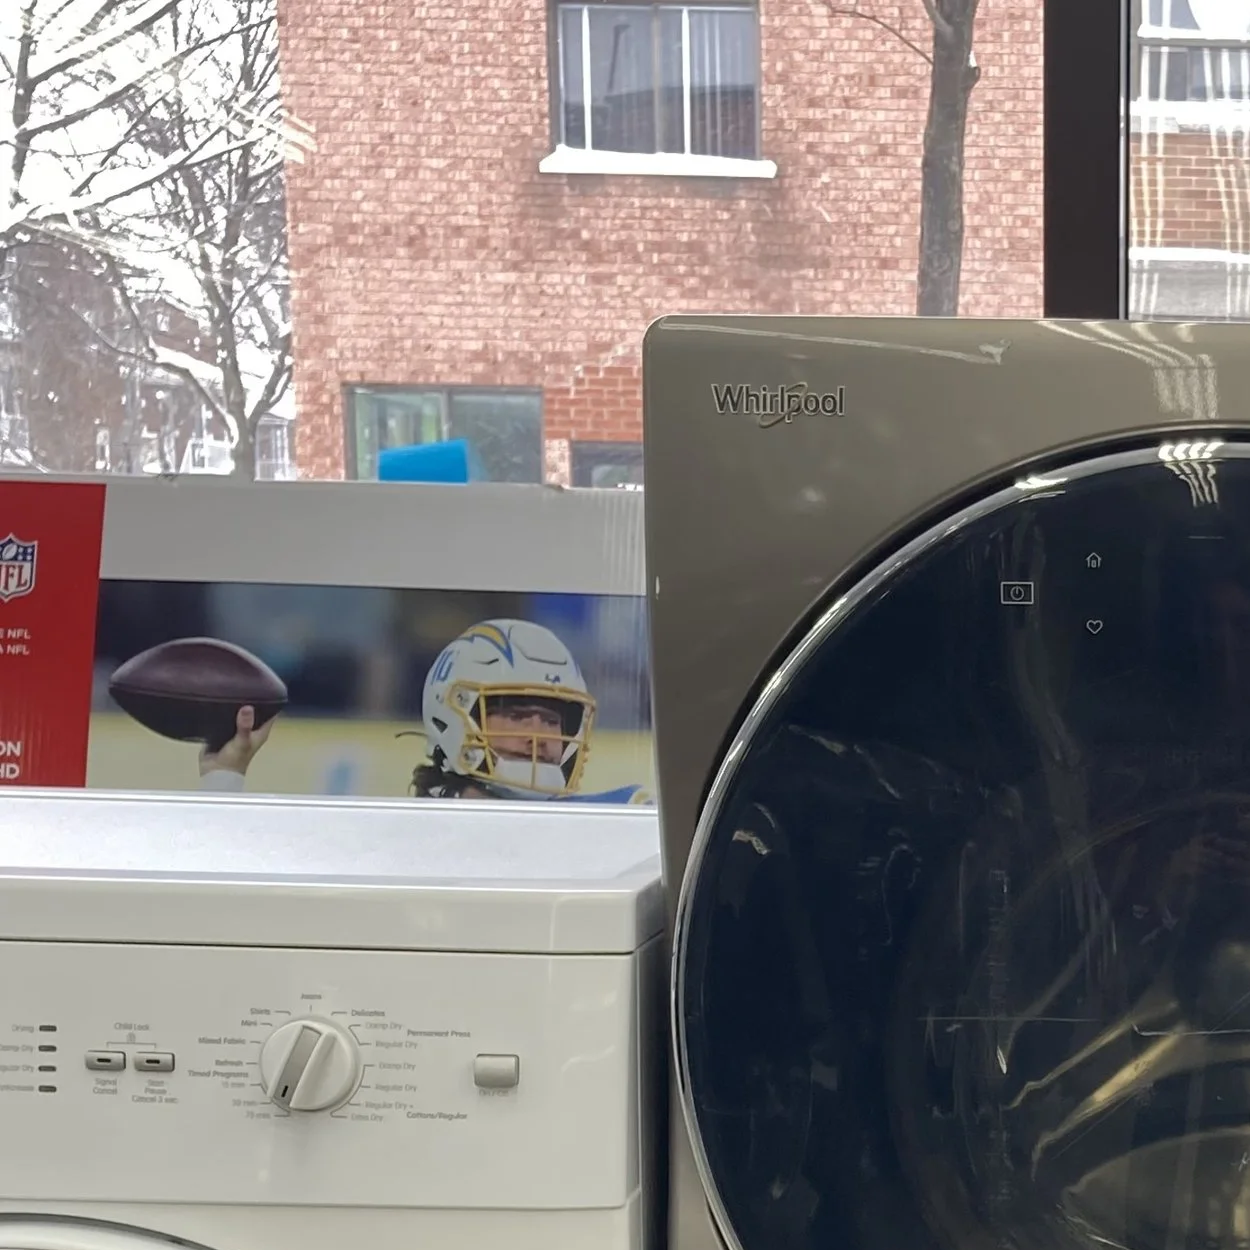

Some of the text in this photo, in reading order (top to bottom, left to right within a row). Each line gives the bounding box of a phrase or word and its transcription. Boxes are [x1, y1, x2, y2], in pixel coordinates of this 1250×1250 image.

[711, 382, 845, 428] Whirlpool
[0, 563, 28, 591] FL
[7, 628, 31, 639] NFL
[7, 644, 30, 655] NFL
[114, 1022, 150, 1031] Child Lock
[390, 1022, 402, 1030] Dry
[405, 1040, 418, 1049] Dry
[403, 1062, 416, 1071] Dry
[405, 1083, 417, 1092] Dry
